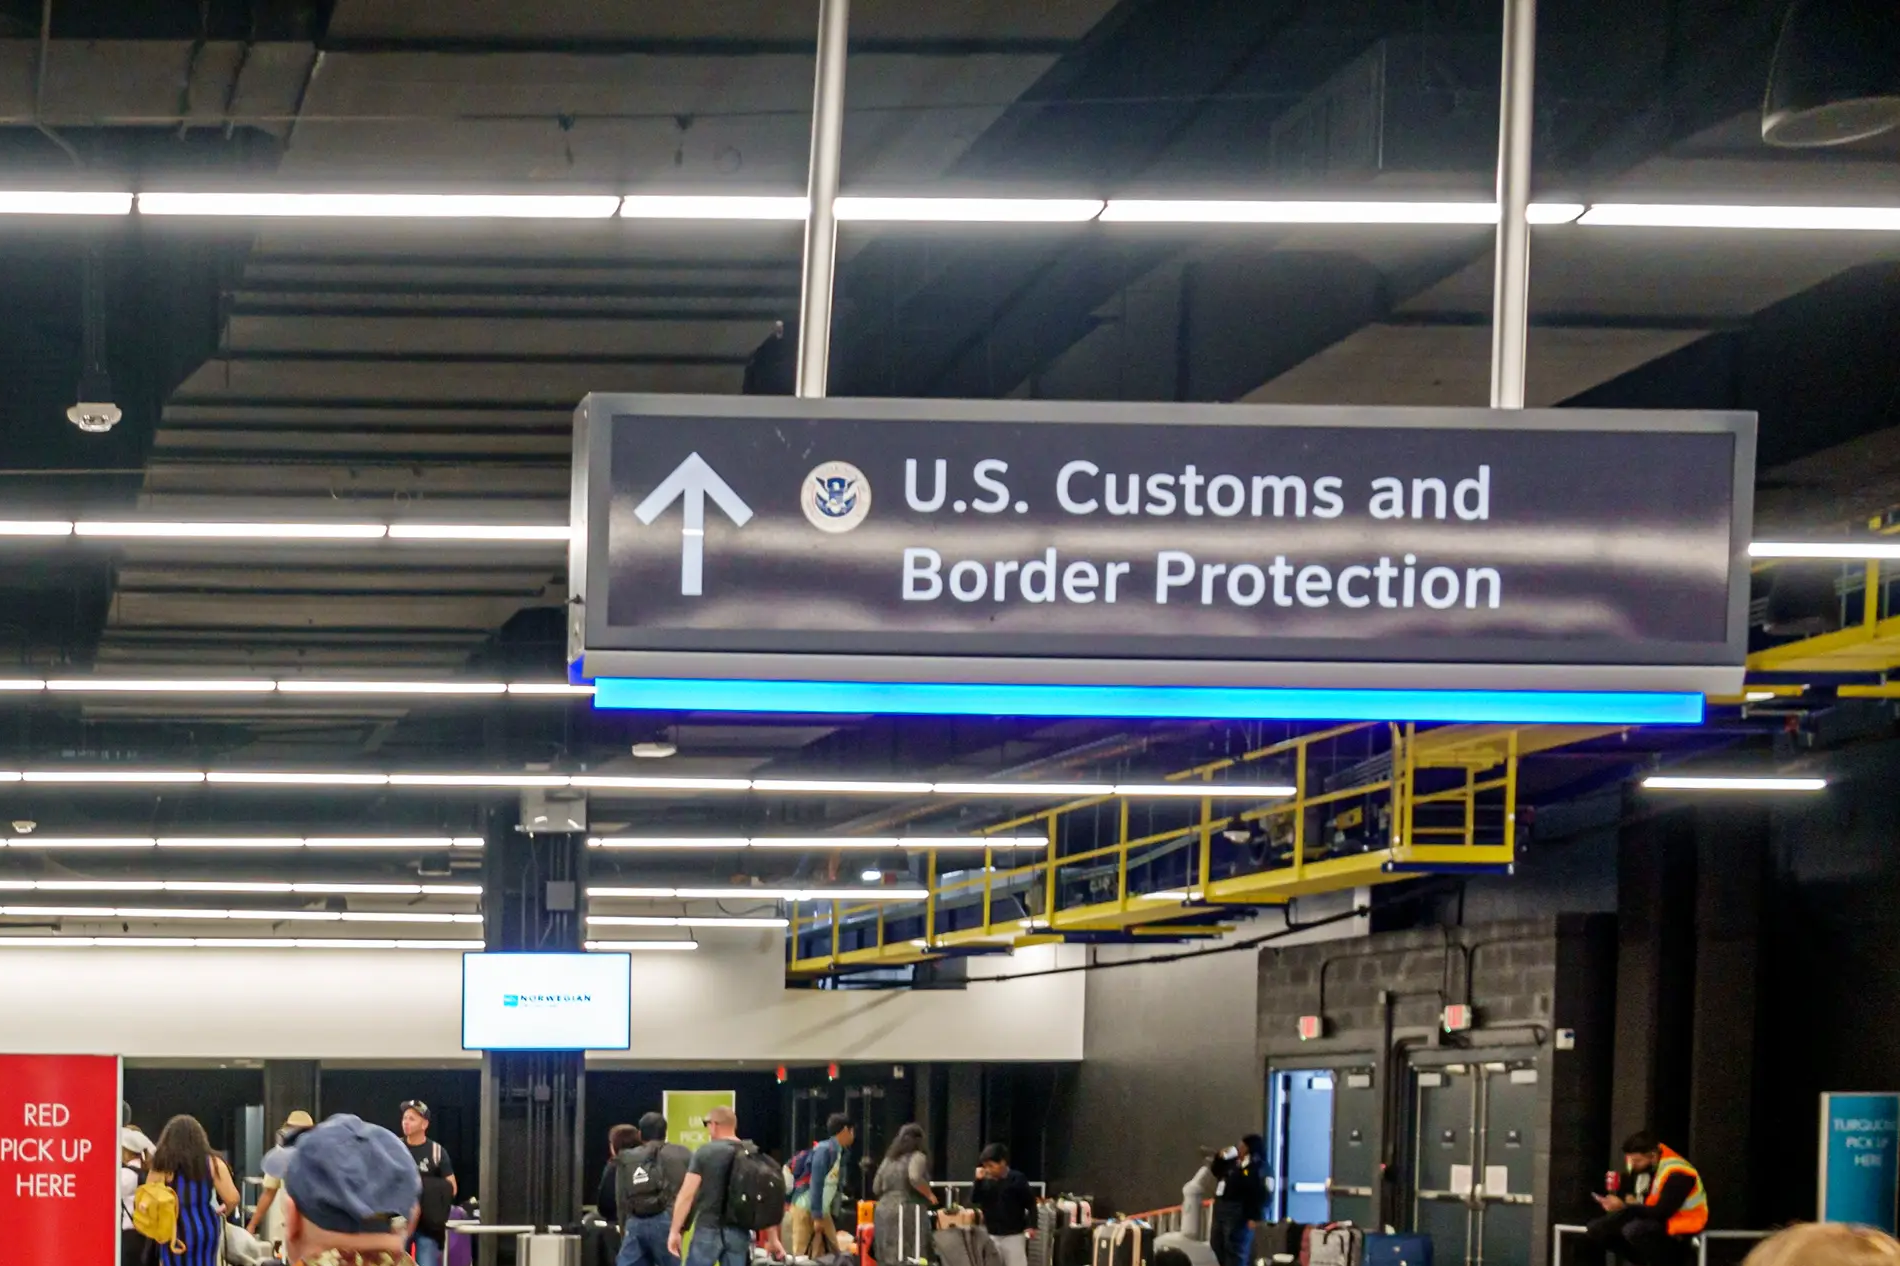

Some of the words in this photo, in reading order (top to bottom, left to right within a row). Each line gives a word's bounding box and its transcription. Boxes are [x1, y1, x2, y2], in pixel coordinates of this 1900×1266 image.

[904, 459, 1030, 514] U.S.
[1055, 460, 1344, 519] Customs
[1369, 465, 1491, 522] and
[901, 547, 1132, 605] Border
[1155, 551, 1502, 611] Protection
[520, 994, 591, 1002] NORWEGIAN
[24, 1103, 70, 1127] RED
[0, 1138, 54, 1162] PICK
[61, 1138, 92, 1163] UP
[16, 1173, 76, 1198] HERE
